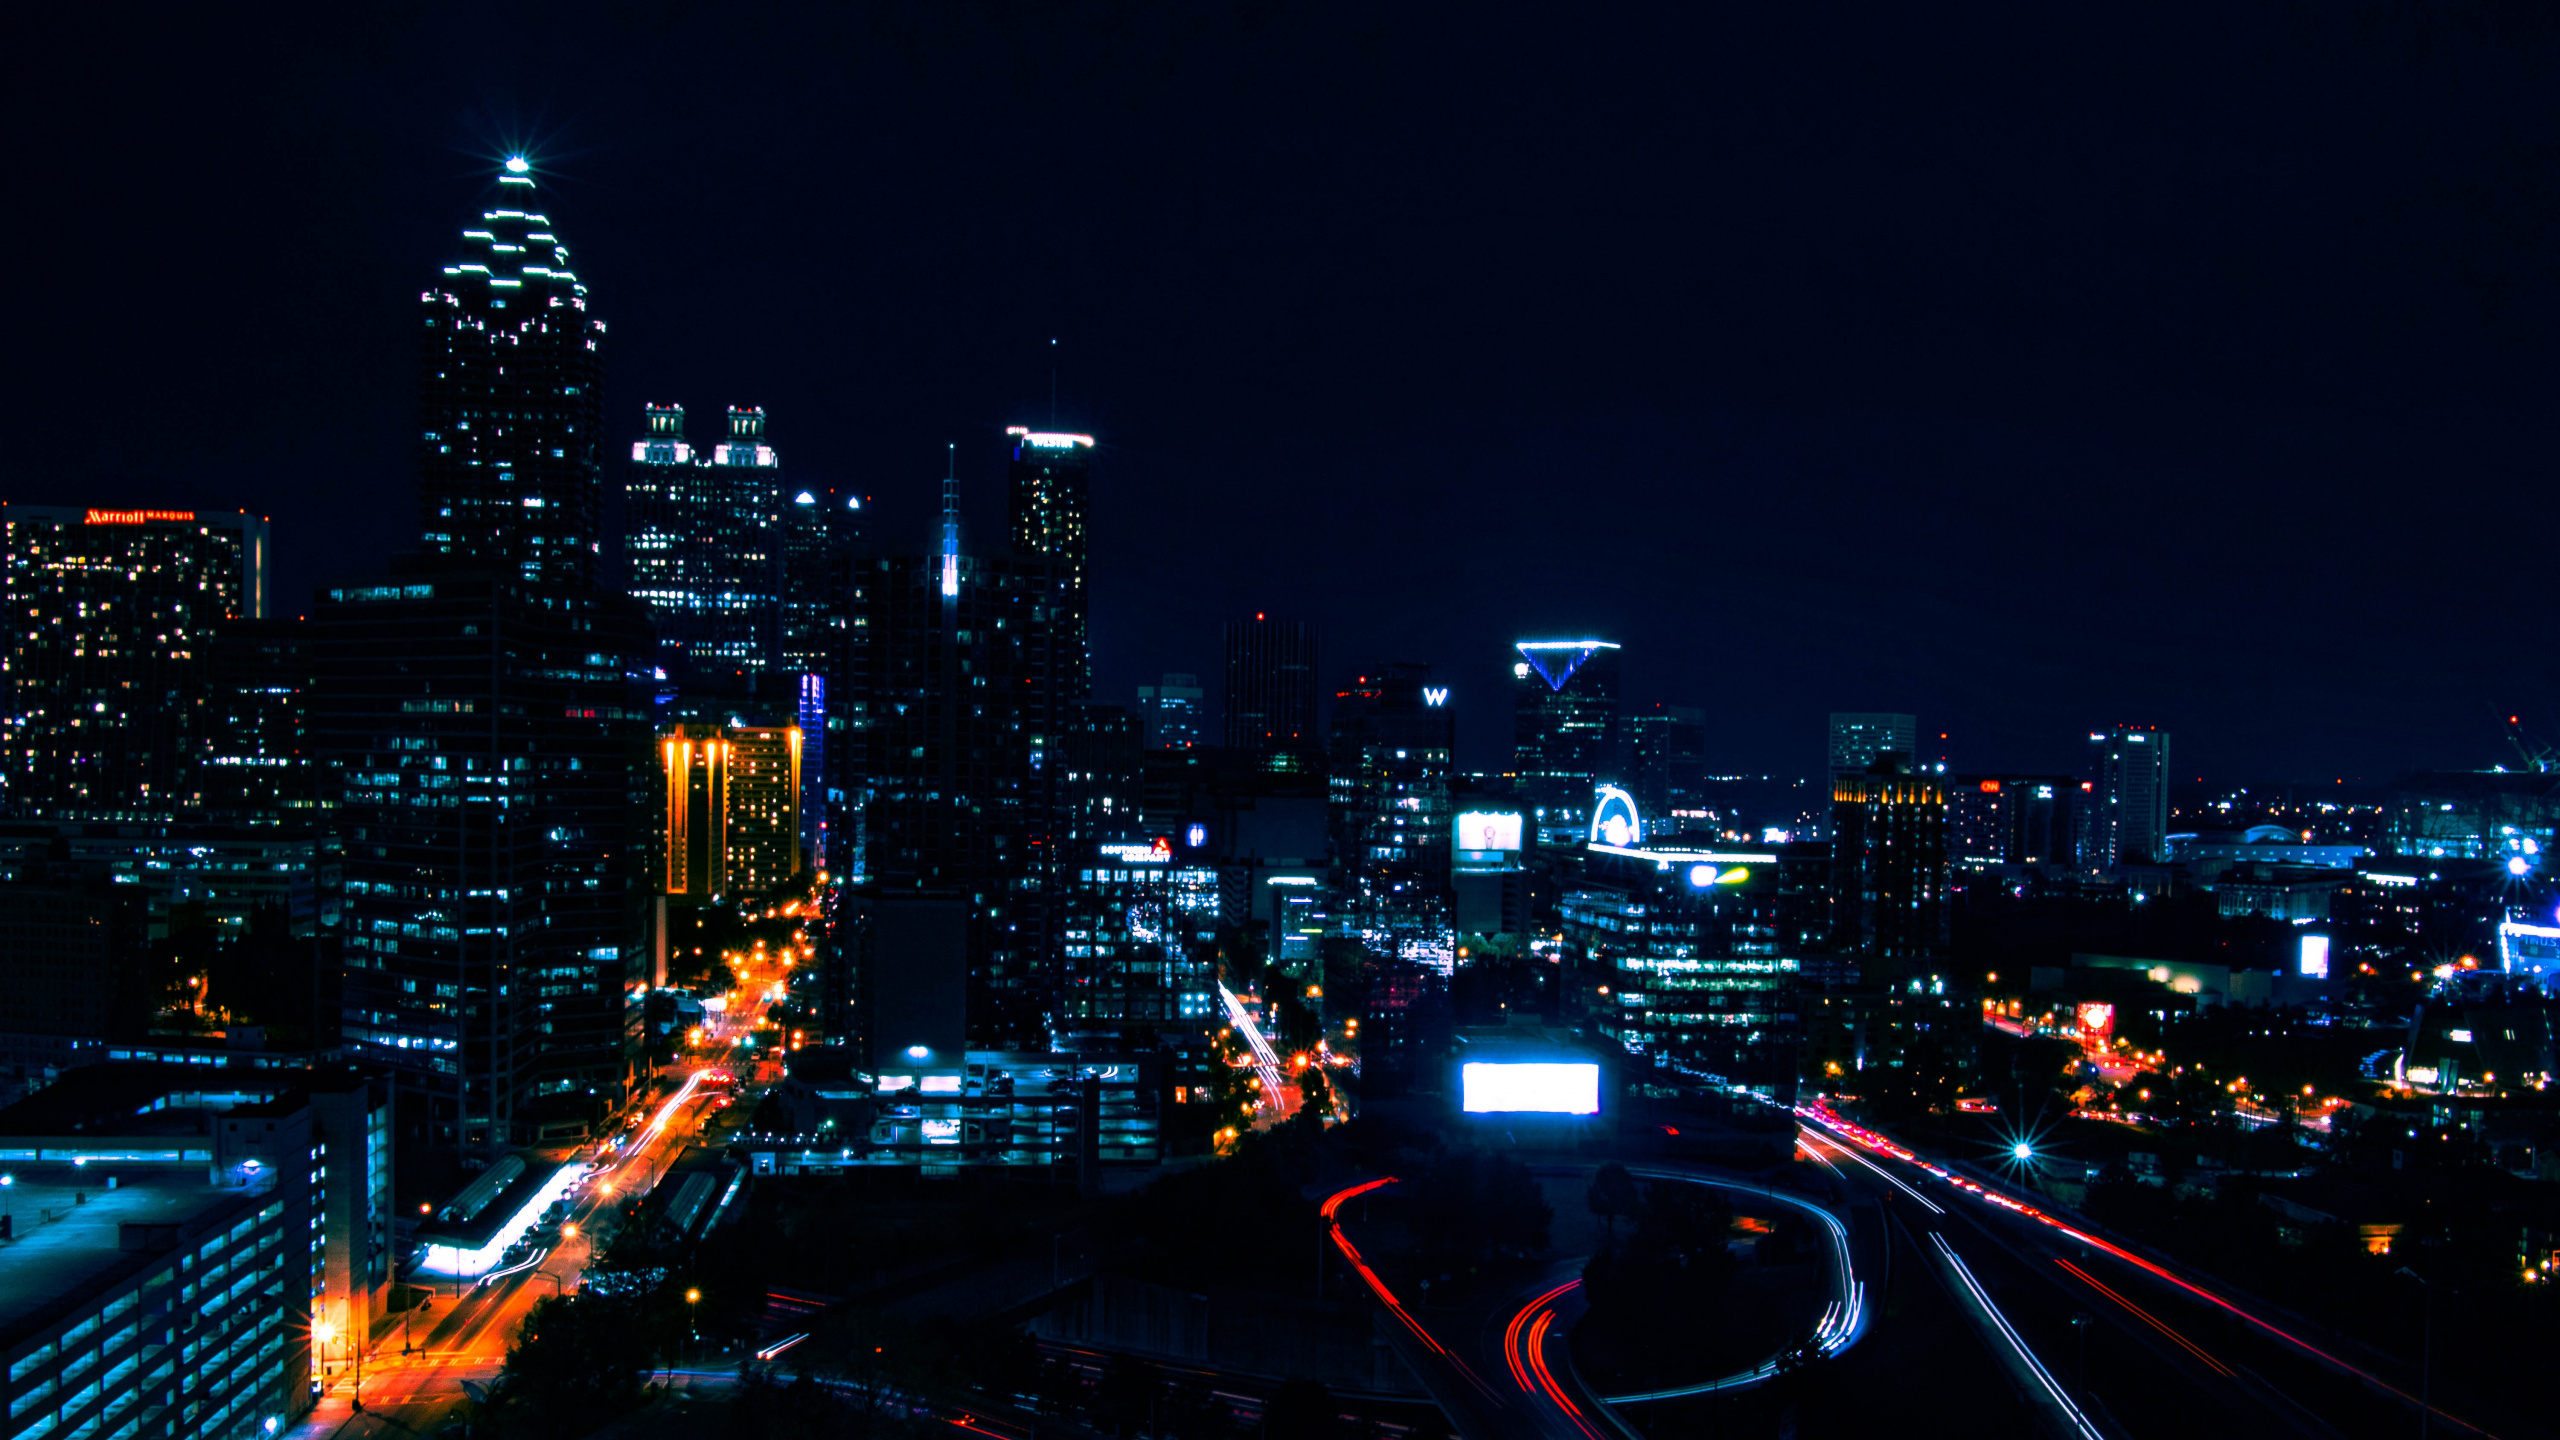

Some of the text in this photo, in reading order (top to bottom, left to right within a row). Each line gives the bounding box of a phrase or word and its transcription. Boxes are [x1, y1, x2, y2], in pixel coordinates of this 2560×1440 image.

[1031, 436, 1073, 448] WESTIN
[85, 509, 194, 524] Marriott MARQUIS
[1422, 687, 1448, 706] W
[1980, 780, 2000, 792] CNN
[1101, 845, 1152, 854] SOUTHERN
[1122, 854, 1171, 862] COMPANY
